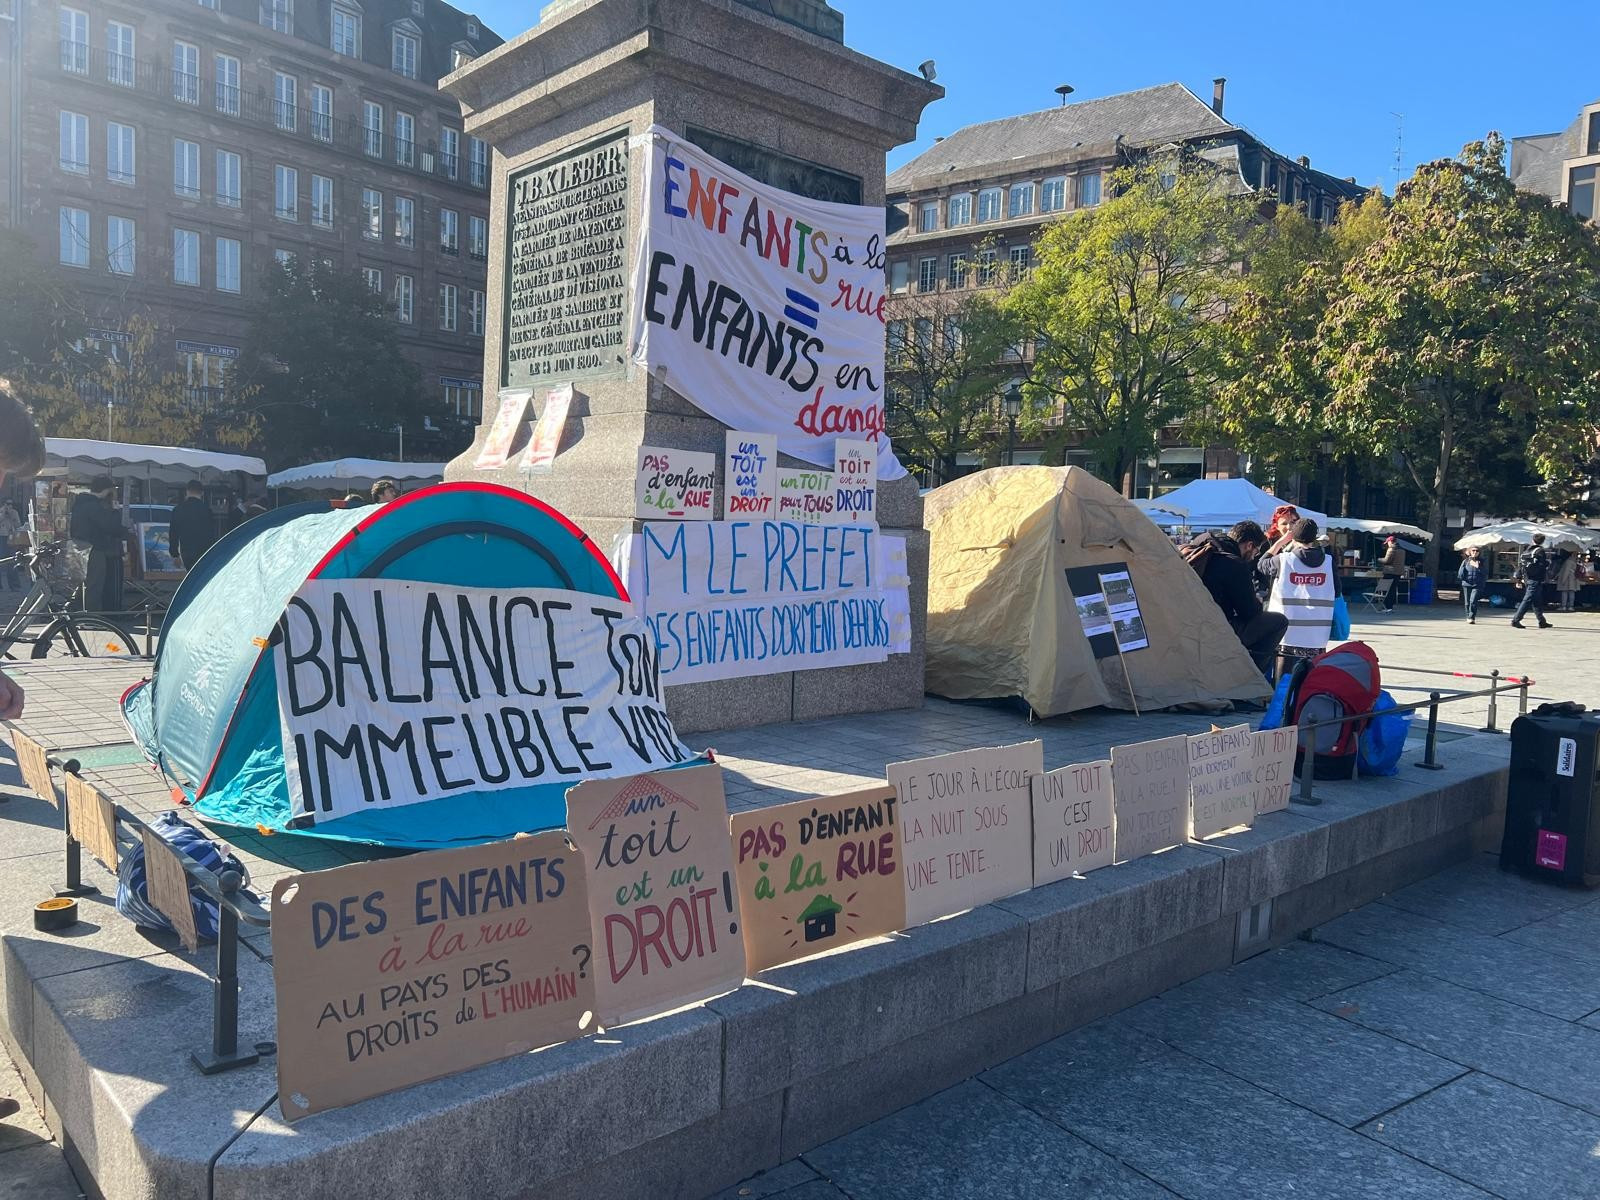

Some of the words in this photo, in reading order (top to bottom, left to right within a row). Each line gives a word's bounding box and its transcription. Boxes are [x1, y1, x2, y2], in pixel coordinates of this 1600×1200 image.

[664, 156, 829, 285] ENFANTS
[831, 237, 854, 266] à
[645, 250, 824, 393] ENFANTS
[834, 363, 880, 392] en
[830, 279, 886, 324] rue
[641, 454, 670, 472] PAS
[738, 441, 760, 456] un
[643, 488, 654, 505] à
[654, 488, 676, 509] la
[683, 490, 712, 508] RUE
[647, 466, 715, 500] d'enfant
[740, 486, 758, 497] un
[779, 496, 802, 512] pour
[780, 476, 799, 491] un
[707, 522, 750, 595] LE
[763, 521, 874, 593] PREFET
[1294, 574, 1322, 585] mrap
[284, 590, 583, 717] BALANCE
[590, 607, 661, 703] TON
[685, 606, 768, 668] ENFANTS
[771, 600, 838, 657] DORMENT
[294, 705, 612, 813] IMMEUBLE
[624, 793, 666, 817] un
[899, 775, 919, 804] LE
[928, 771, 966, 801] JOUR
[971, 767, 980, 793] À
[1042, 774, 1064, 803] UN
[1072, 765, 1102, 794] TOIT
[798, 797, 897, 845] D'ENFANT
[903, 817, 924, 844] LA
[931, 809, 965, 836] NUIT
[974, 804, 1008, 832] SOUS
[1063, 800, 1092, 826] C'EST
[595, 810, 692, 870] toit
[739, 821, 787, 864] PAS
[1049, 837, 1070, 868] UN
[1078, 825, 1111, 858] DROIT
[615, 870, 654, 906] est
[666, 864, 705, 890] un
[755, 862, 776, 900] à
[784, 853, 828, 893] la
[836, 832, 897, 882] RUE
[906, 857, 938, 892] UNE
[311, 890, 388, 949] DES
[415, 857, 565, 926] ENFANTS
[378, 932, 406, 974] à
[416, 922, 468, 964] la
[475, 916, 532, 948] rue
[316, 993, 365, 1029] AU
[380, 973, 449, 1011] PAYS
[463, 959, 511, 992] DES
[455, 999, 478, 1025] de
